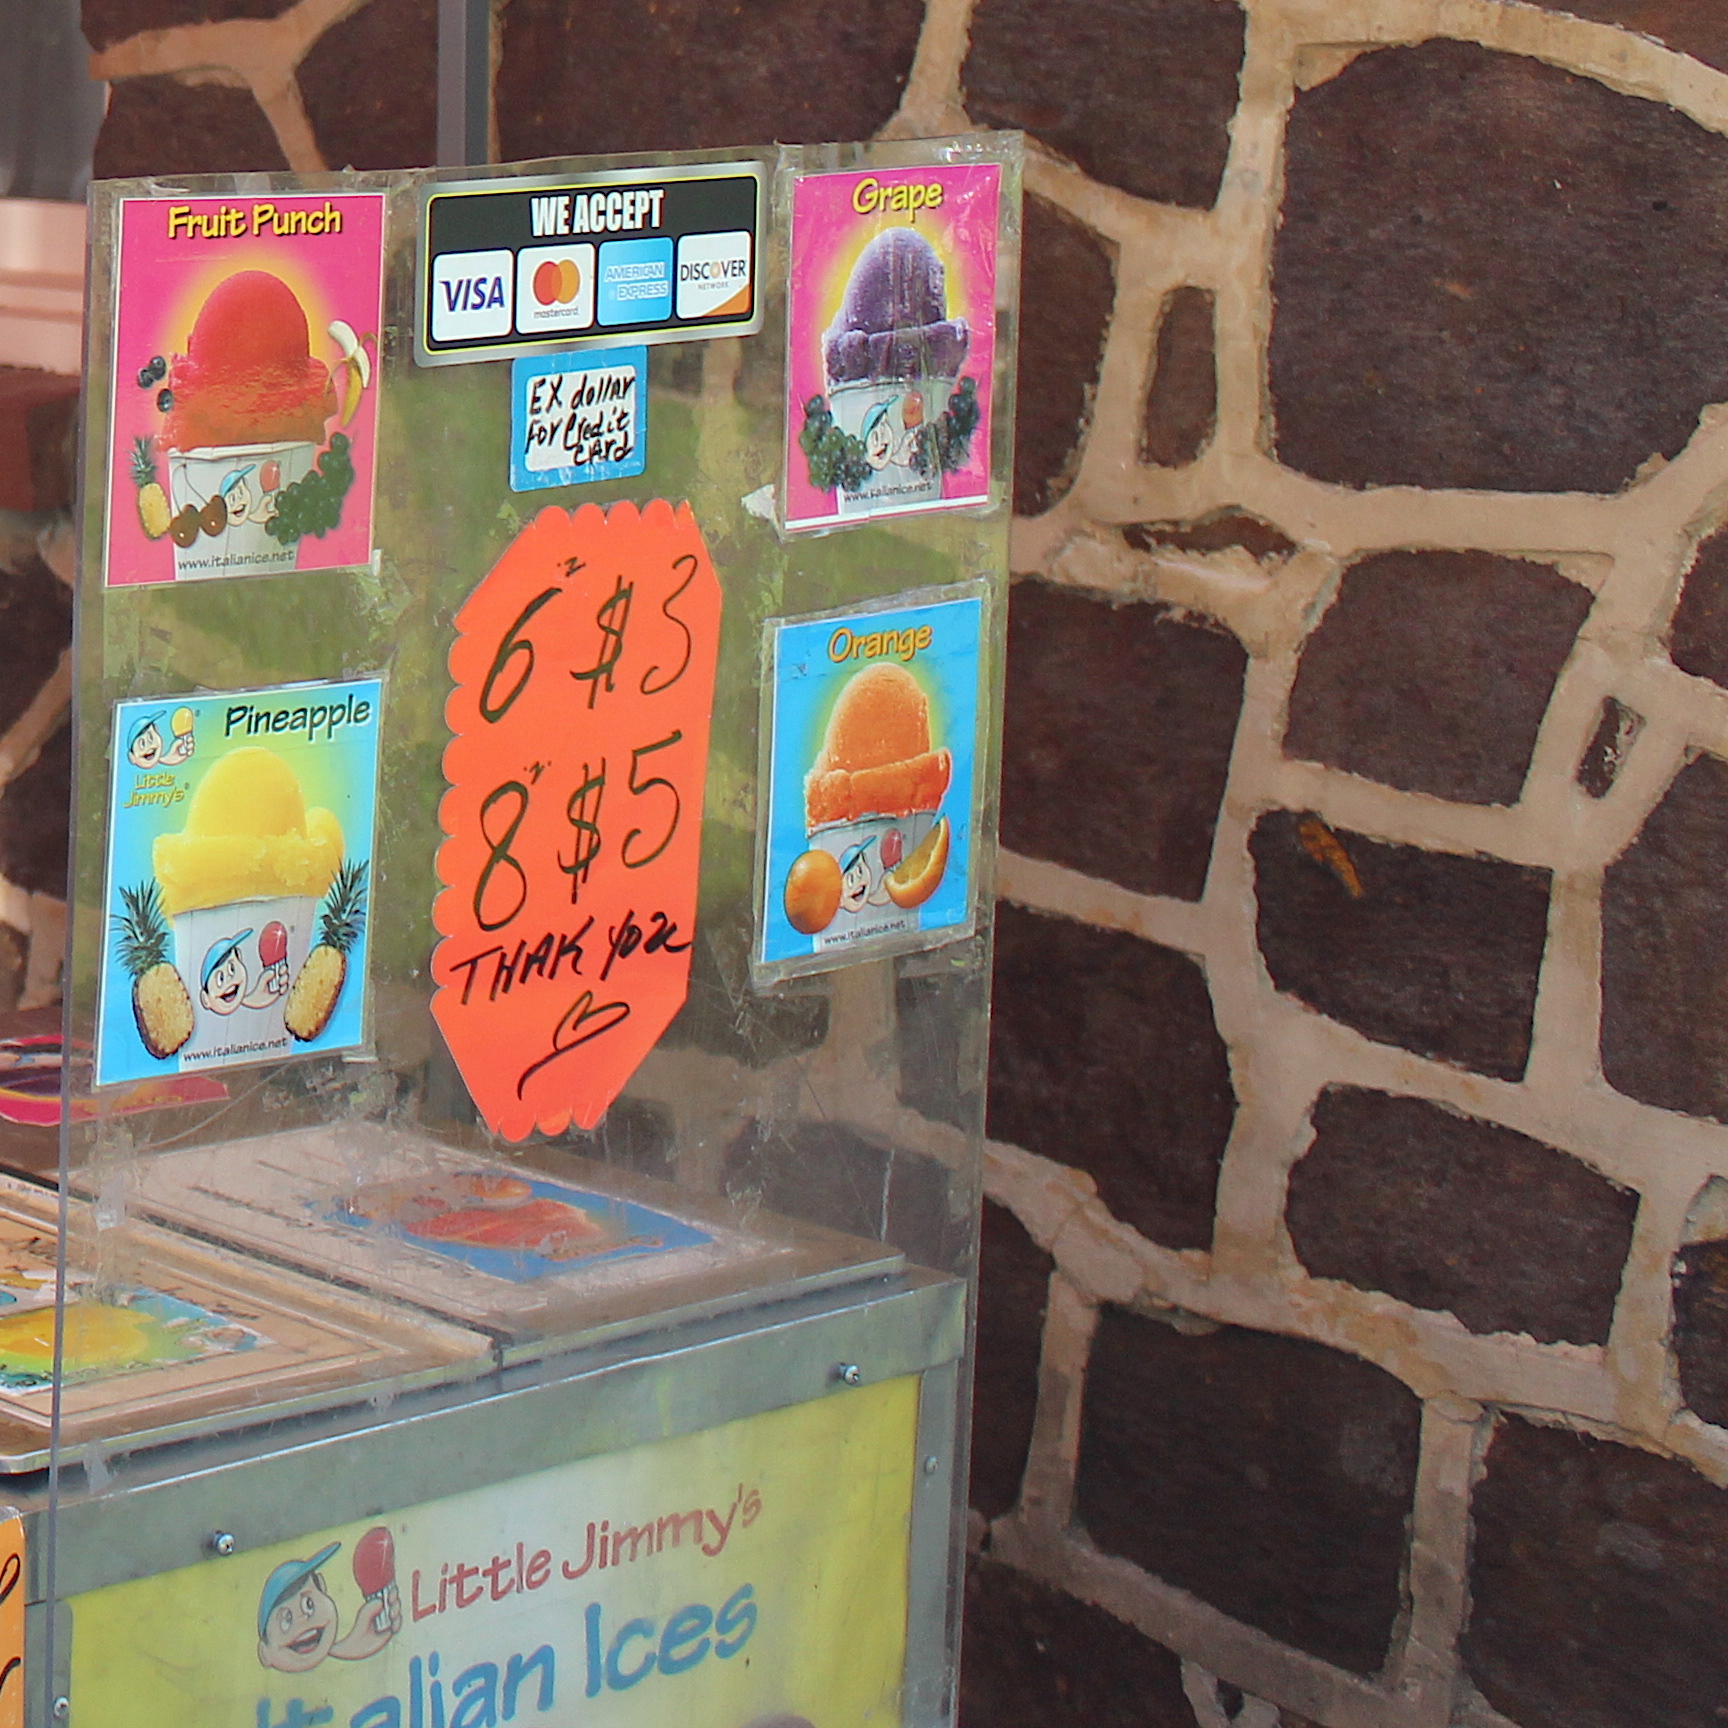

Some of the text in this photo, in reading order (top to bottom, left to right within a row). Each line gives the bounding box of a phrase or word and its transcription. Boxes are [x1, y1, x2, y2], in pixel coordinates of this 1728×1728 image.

[531, 189, 664, 237] WE ACCEPT
[851, 177, 943, 223] Grape
[168, 202, 343, 240] Fruit Punch
[604, 262, 666, 281] AMERICAN
[680, 260, 747, 281] DISCOVER
[439, 275, 506, 313] VISA
[616, 281, 669, 302] EXPRESS
[697, 281, 730, 291] NETWORK
[533, 306, 579, 319] mastercard
[529, 374, 563, 415] EX
[177, 549, 296, 572] www.italianice.net
[828, 625, 933, 663] Orange
[224, 694, 371, 742] Pineapple
[133, 772, 177, 789] Little
[122, 788, 186, 809] Jimmy's
[823, 919, 907, 946] www.italianice.net
[183, 1036, 289, 1062] www.italianice.net
[411, 1483, 762, 1622] Little Jimmy's
[584, 1583, 758, 1699] Ices
